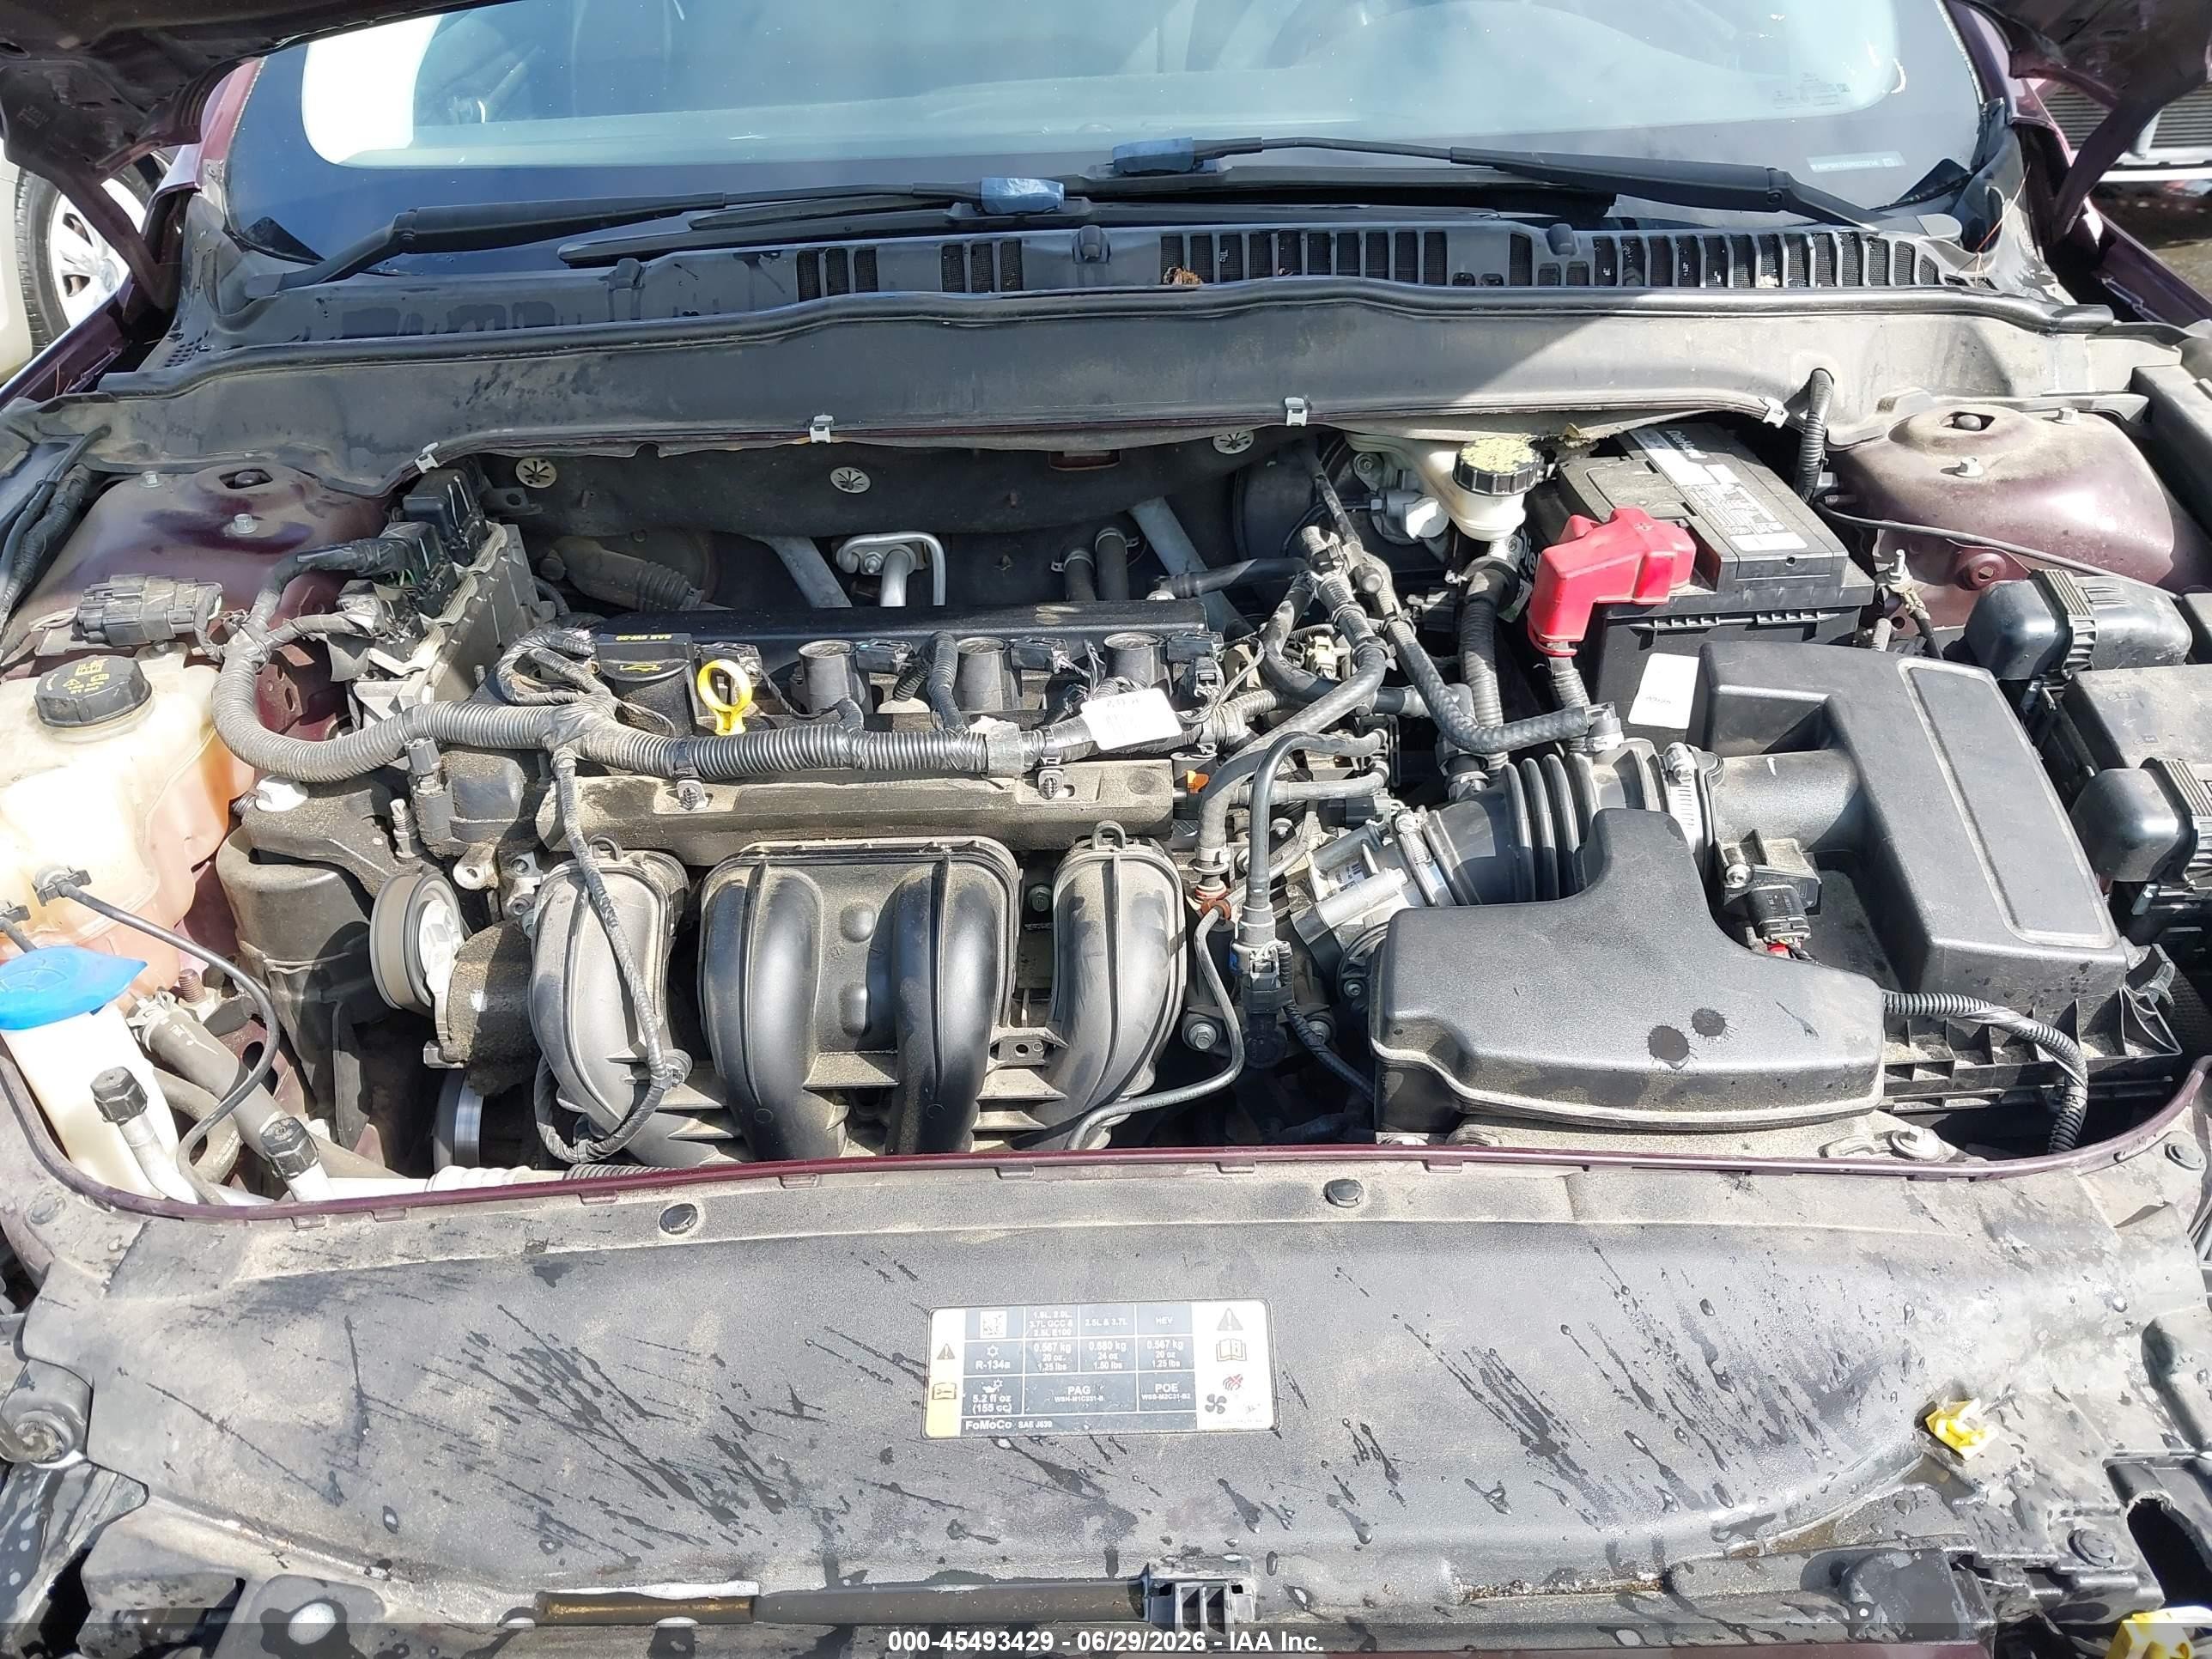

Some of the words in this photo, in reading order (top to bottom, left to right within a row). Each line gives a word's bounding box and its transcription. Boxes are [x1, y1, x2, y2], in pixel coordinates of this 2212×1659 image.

[1085, 1318, 1102, 1327] 2.5L
[1111, 1317, 1128, 1326] 3.7L
[1155, 1316, 1174, 1325] HEV
[1060, 1342, 1072, 1354] kg
[1088, 1340, 1113, 1351] 0.680
[1115, 1340, 1127, 1352] kg
[1146, 1339, 1171, 1350] 0.567
[1173, 1339, 1184, 1351] kg
[1042, 1353, 1051, 1362] 20
[1097, 1352, 1107, 1360] 24
[1155, 1350, 1164, 1358] 20
[975, 1359, 1011, 1370] R-134a
[1054, 1362, 1067, 1370] lbs
[1093, 1361, 1109, 1370] 1.50
[1152, 1359, 1167, 1368] 1.25
[1168, 1359, 1181, 1368] lbs
[1067, 1385, 1091, 1395] PAG
[1154, 1382, 1179, 1393] POE
[972, 1394, 988, 1403] 5.2
[989, 1394, 997, 1402] fl
[972, 1403, 994, 1415] (155
[996, 1402, 1012, 1414] cc)
[965, 1419, 1012, 1431] FoMoCo
[1018, 1420, 1035, 1429] SAE
[1036, 1420, 1053, 1429] J639
